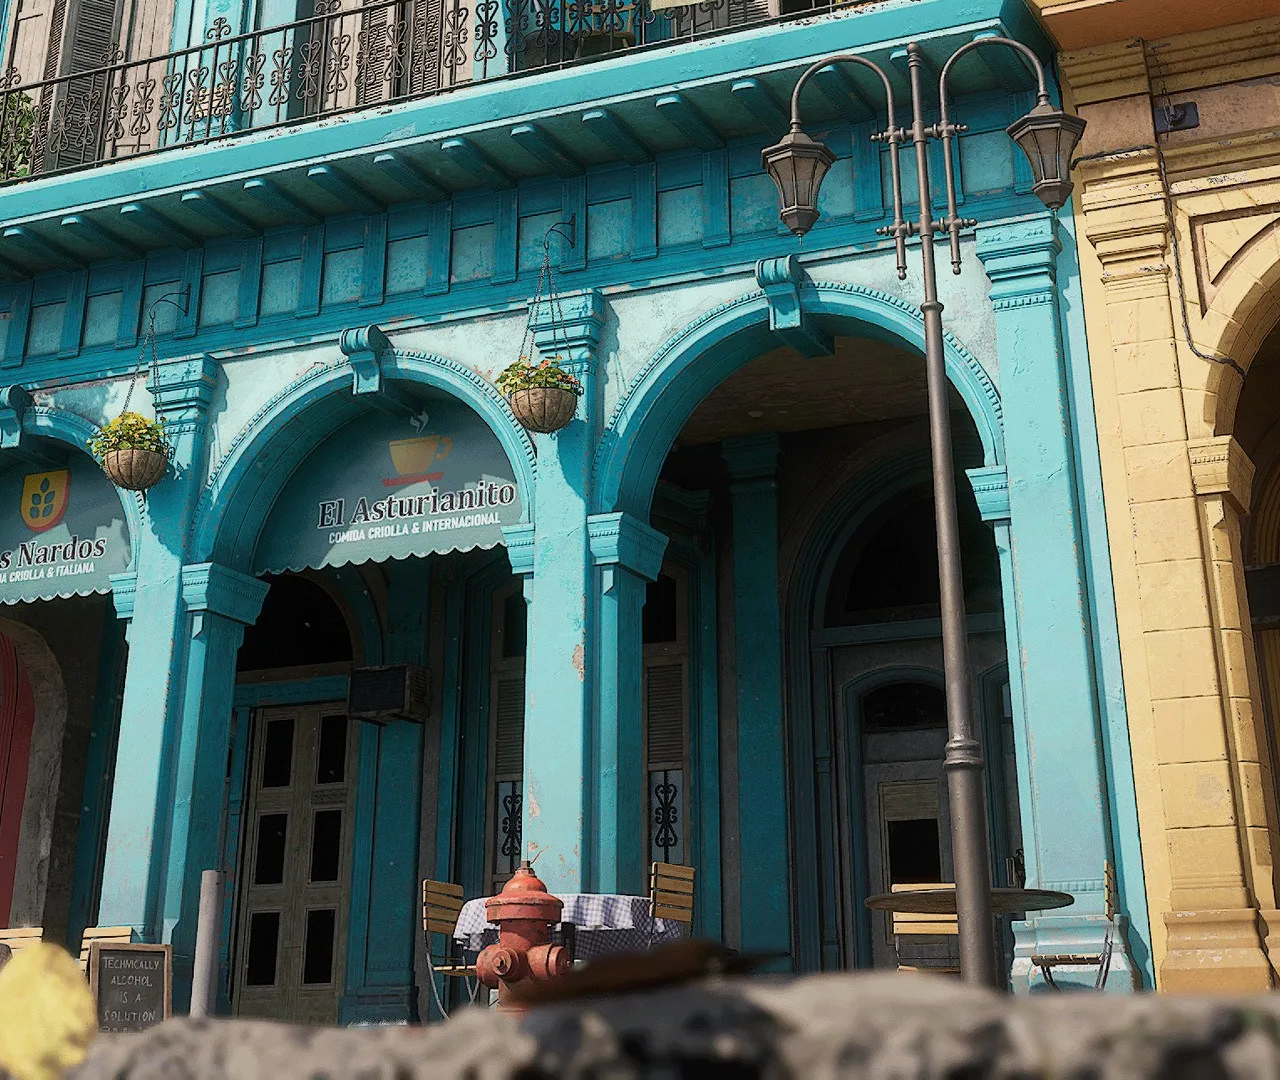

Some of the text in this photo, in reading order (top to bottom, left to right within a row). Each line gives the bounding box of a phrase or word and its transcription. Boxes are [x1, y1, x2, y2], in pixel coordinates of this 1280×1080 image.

[318, 480, 516, 529] El Asturianito
[328, 511, 501, 544] COMIDA CRIOLLA & INTERNACIONAL
[16, 534, 107, 568] Nardos
[9, 569, 45, 582] CRIOLLA
[46, 566, 55, 578] &
[56, 561, 95, 577] ITALIANA
[101, 956, 160, 970] TECHNICALLY
[111, 975, 153, 986] ALCOHOL
[121, 991, 141, 1003] IS A
[104, 1010, 156, 1021] SOLUTION
